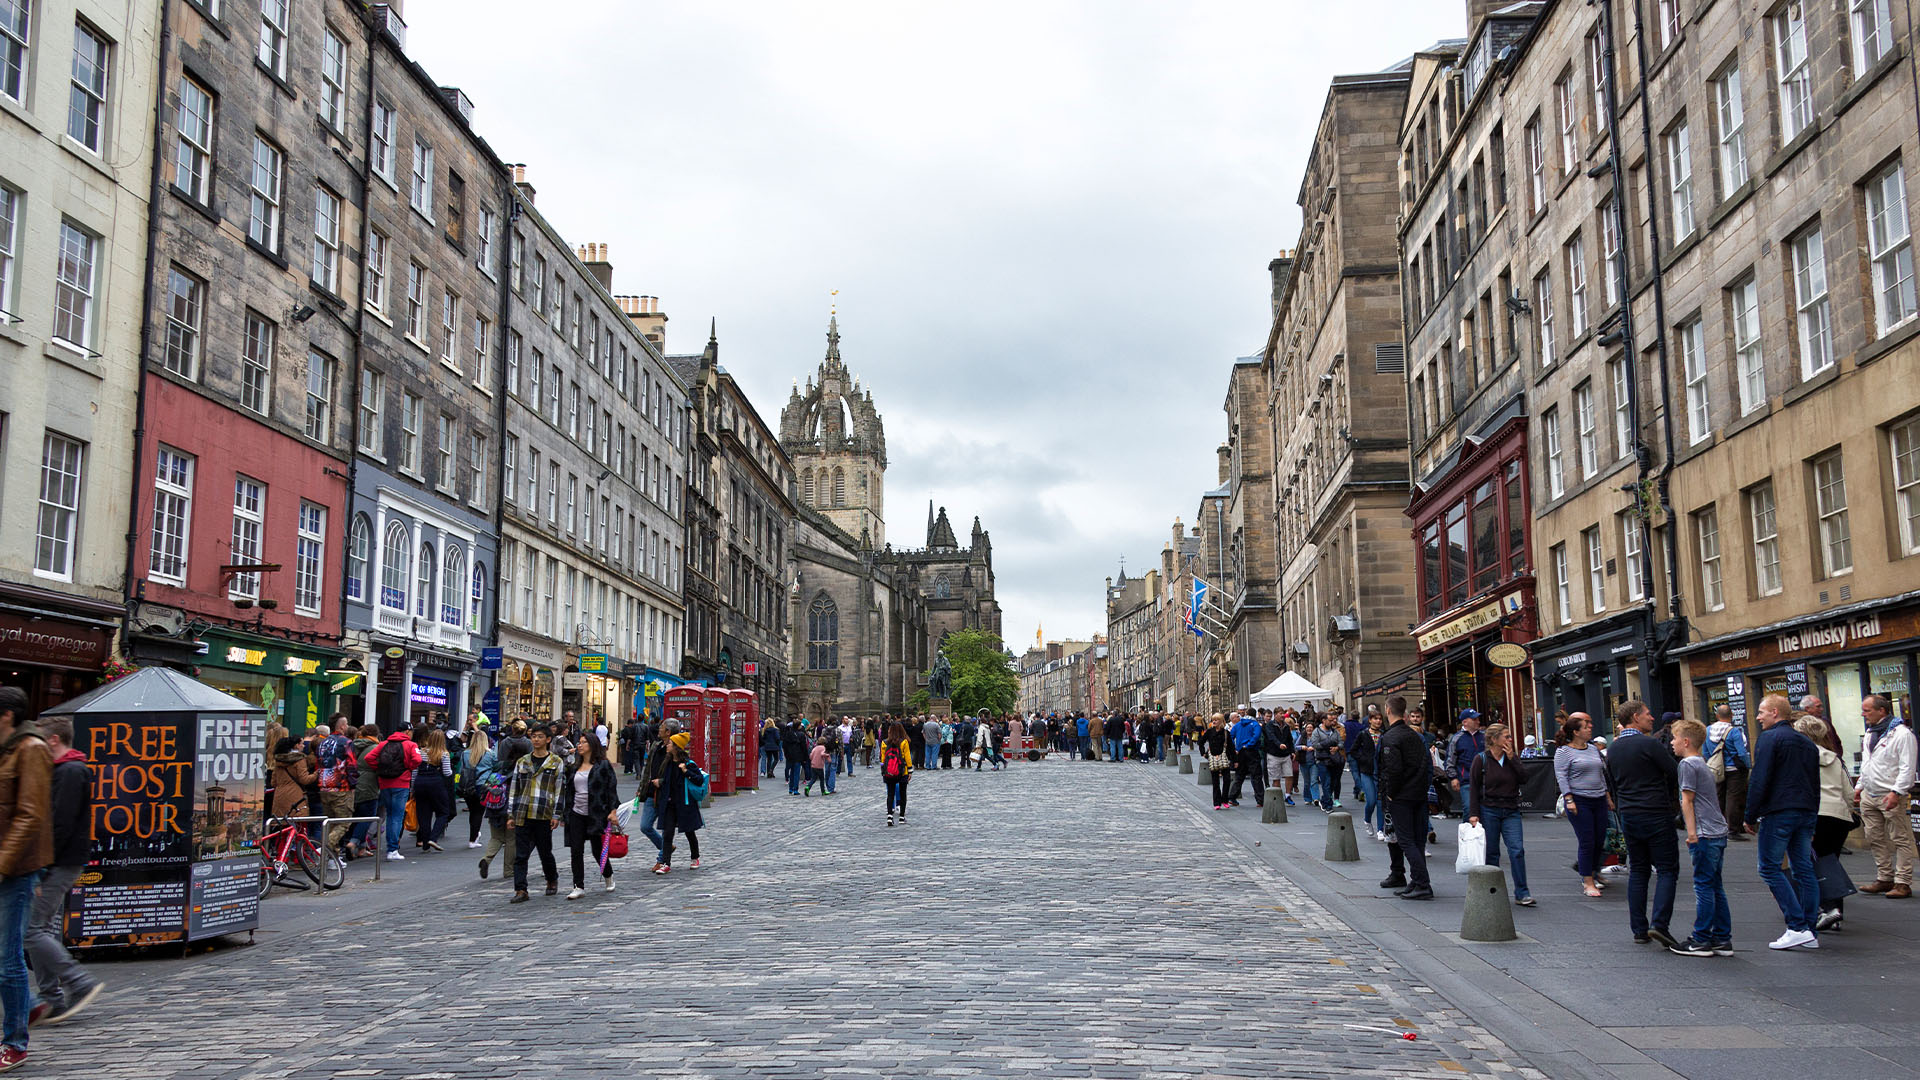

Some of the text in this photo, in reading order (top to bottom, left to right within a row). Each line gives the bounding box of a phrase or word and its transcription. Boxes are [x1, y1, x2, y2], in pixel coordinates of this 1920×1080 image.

[0, 626, 22, 643] yal
[1428, 632, 1440, 645] THE
[1441, 623, 1462, 640] FILLING
[1776, 613, 1881, 654] The Whisky Trail
[225, 646, 267, 666] SUBWAY
[508, 641, 554, 660] TASTE OF SCOTLAND
[1732, 648, 1750, 660] Whisky
[284, 656, 320, 674] SUBWAY
[416, 652, 424, 662] OF
[427, 655, 451, 668] BENGAL
[1787, 671, 1805, 682] SCOTCH
[1872, 663, 1904, 678] Whisky
[330, 674, 359, 693] SUBWAY
[419, 685, 426, 693] OF
[427, 686, 447, 697] BENGAL
[1765, 679, 1787, 693] Scottis
[1787, 682, 1807, 693] WHISKY
[87, 722, 177, 762] FREE
[200, 719, 266, 750] FREE
[198, 752, 265, 782] TOUR
[90, 801, 185, 841] TOUR
[101, 855, 188, 867] freeghosttour.com
